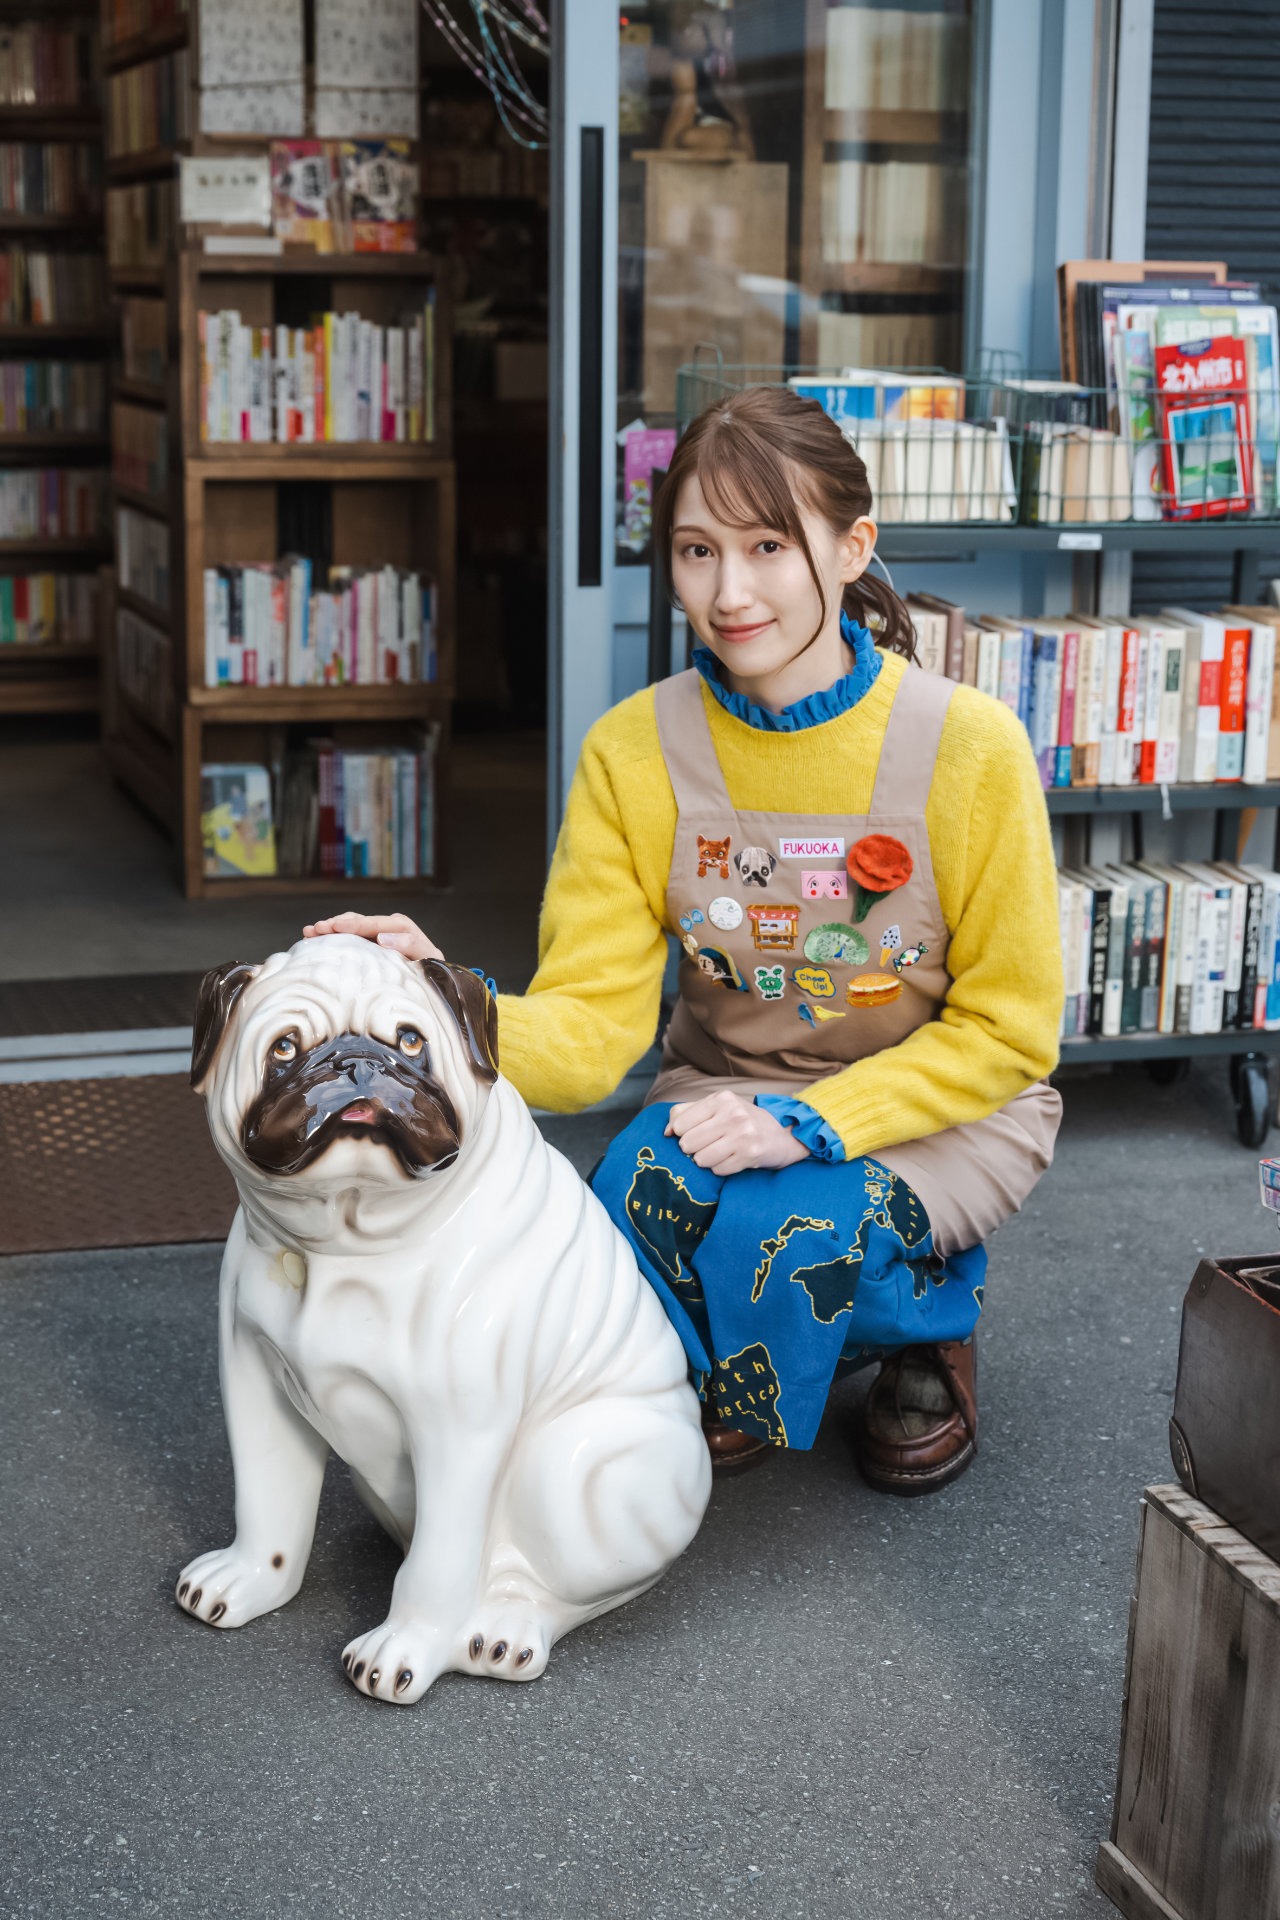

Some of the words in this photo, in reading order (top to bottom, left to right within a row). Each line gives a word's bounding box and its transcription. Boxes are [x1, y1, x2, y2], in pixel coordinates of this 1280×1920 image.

[1162, 357, 1233, 392] 北九州市
[783, 842, 840, 855] FUKUOKA
[799, 973, 825, 982] Cheer
[813, 981, 828, 991] Up!
